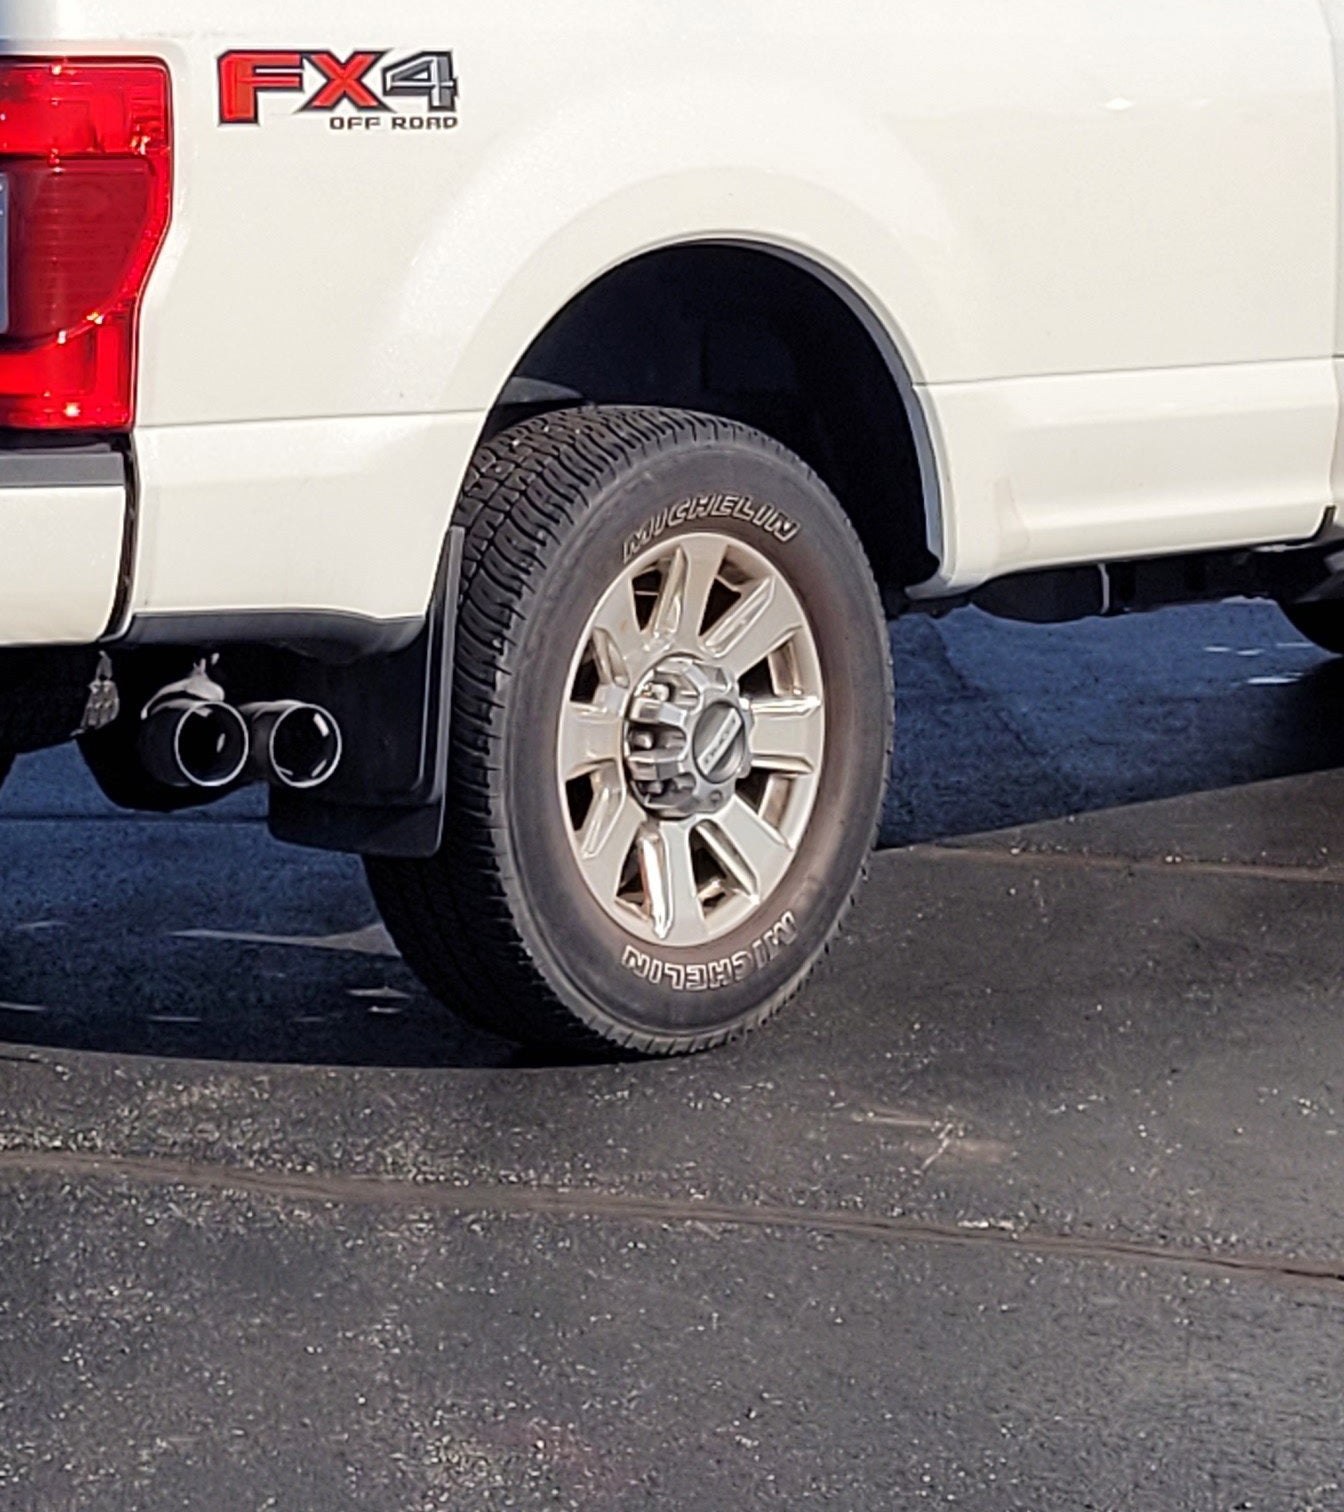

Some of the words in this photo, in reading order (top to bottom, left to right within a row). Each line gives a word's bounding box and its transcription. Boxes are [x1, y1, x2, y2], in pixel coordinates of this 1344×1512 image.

[218, 48, 458, 126] FX4
[329, 116, 381, 130] OFF
[391, 116, 458, 130] ROAD
[623, 493, 802, 565] MICHELIN
[621, 910, 799, 991] MICHELIN
